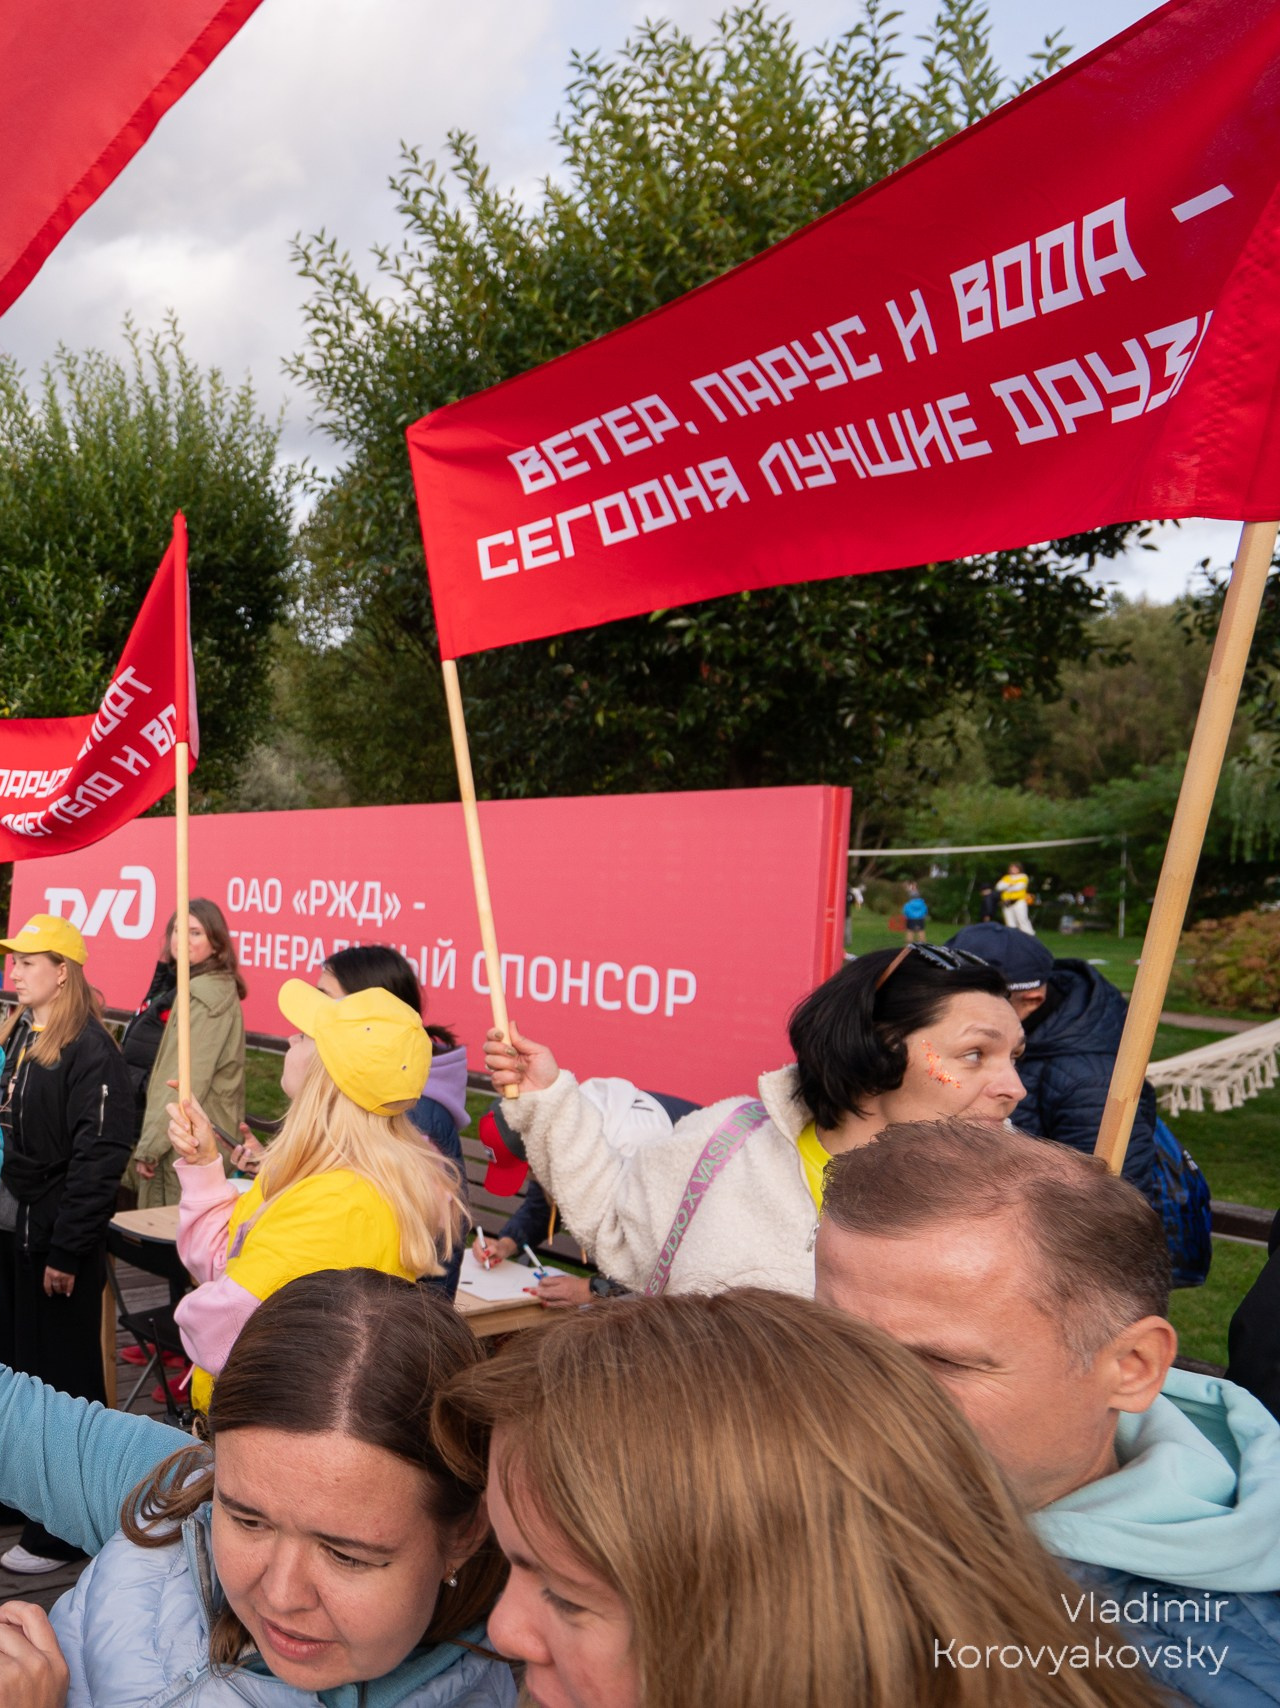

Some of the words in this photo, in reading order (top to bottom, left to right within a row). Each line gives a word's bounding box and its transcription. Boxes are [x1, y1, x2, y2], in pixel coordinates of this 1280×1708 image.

[508, 393, 700, 495] ВЕТЕР,
[689, 315, 883, 423] ПАРУС
[885, 289, 938, 363] И
[950, 197, 1147, 343] ВОДА
[476, 455, 750, 582] СЕГОДНЯ
[758, 392, 993, 496] ЛУЧШИЕ
[989, 310, 1214, 446] ДРУЗ
[48, 770, 124, 824] ТЕЛО
[227, 877, 283, 914] ОАО
[292, 879, 402, 928] «РЖД»
[228, 930, 457, 990] ЕНЕРАЫЙ
[471, 951, 697, 1017] СПОНСОР
[649, 1207, 689, 1297] STUDIO
